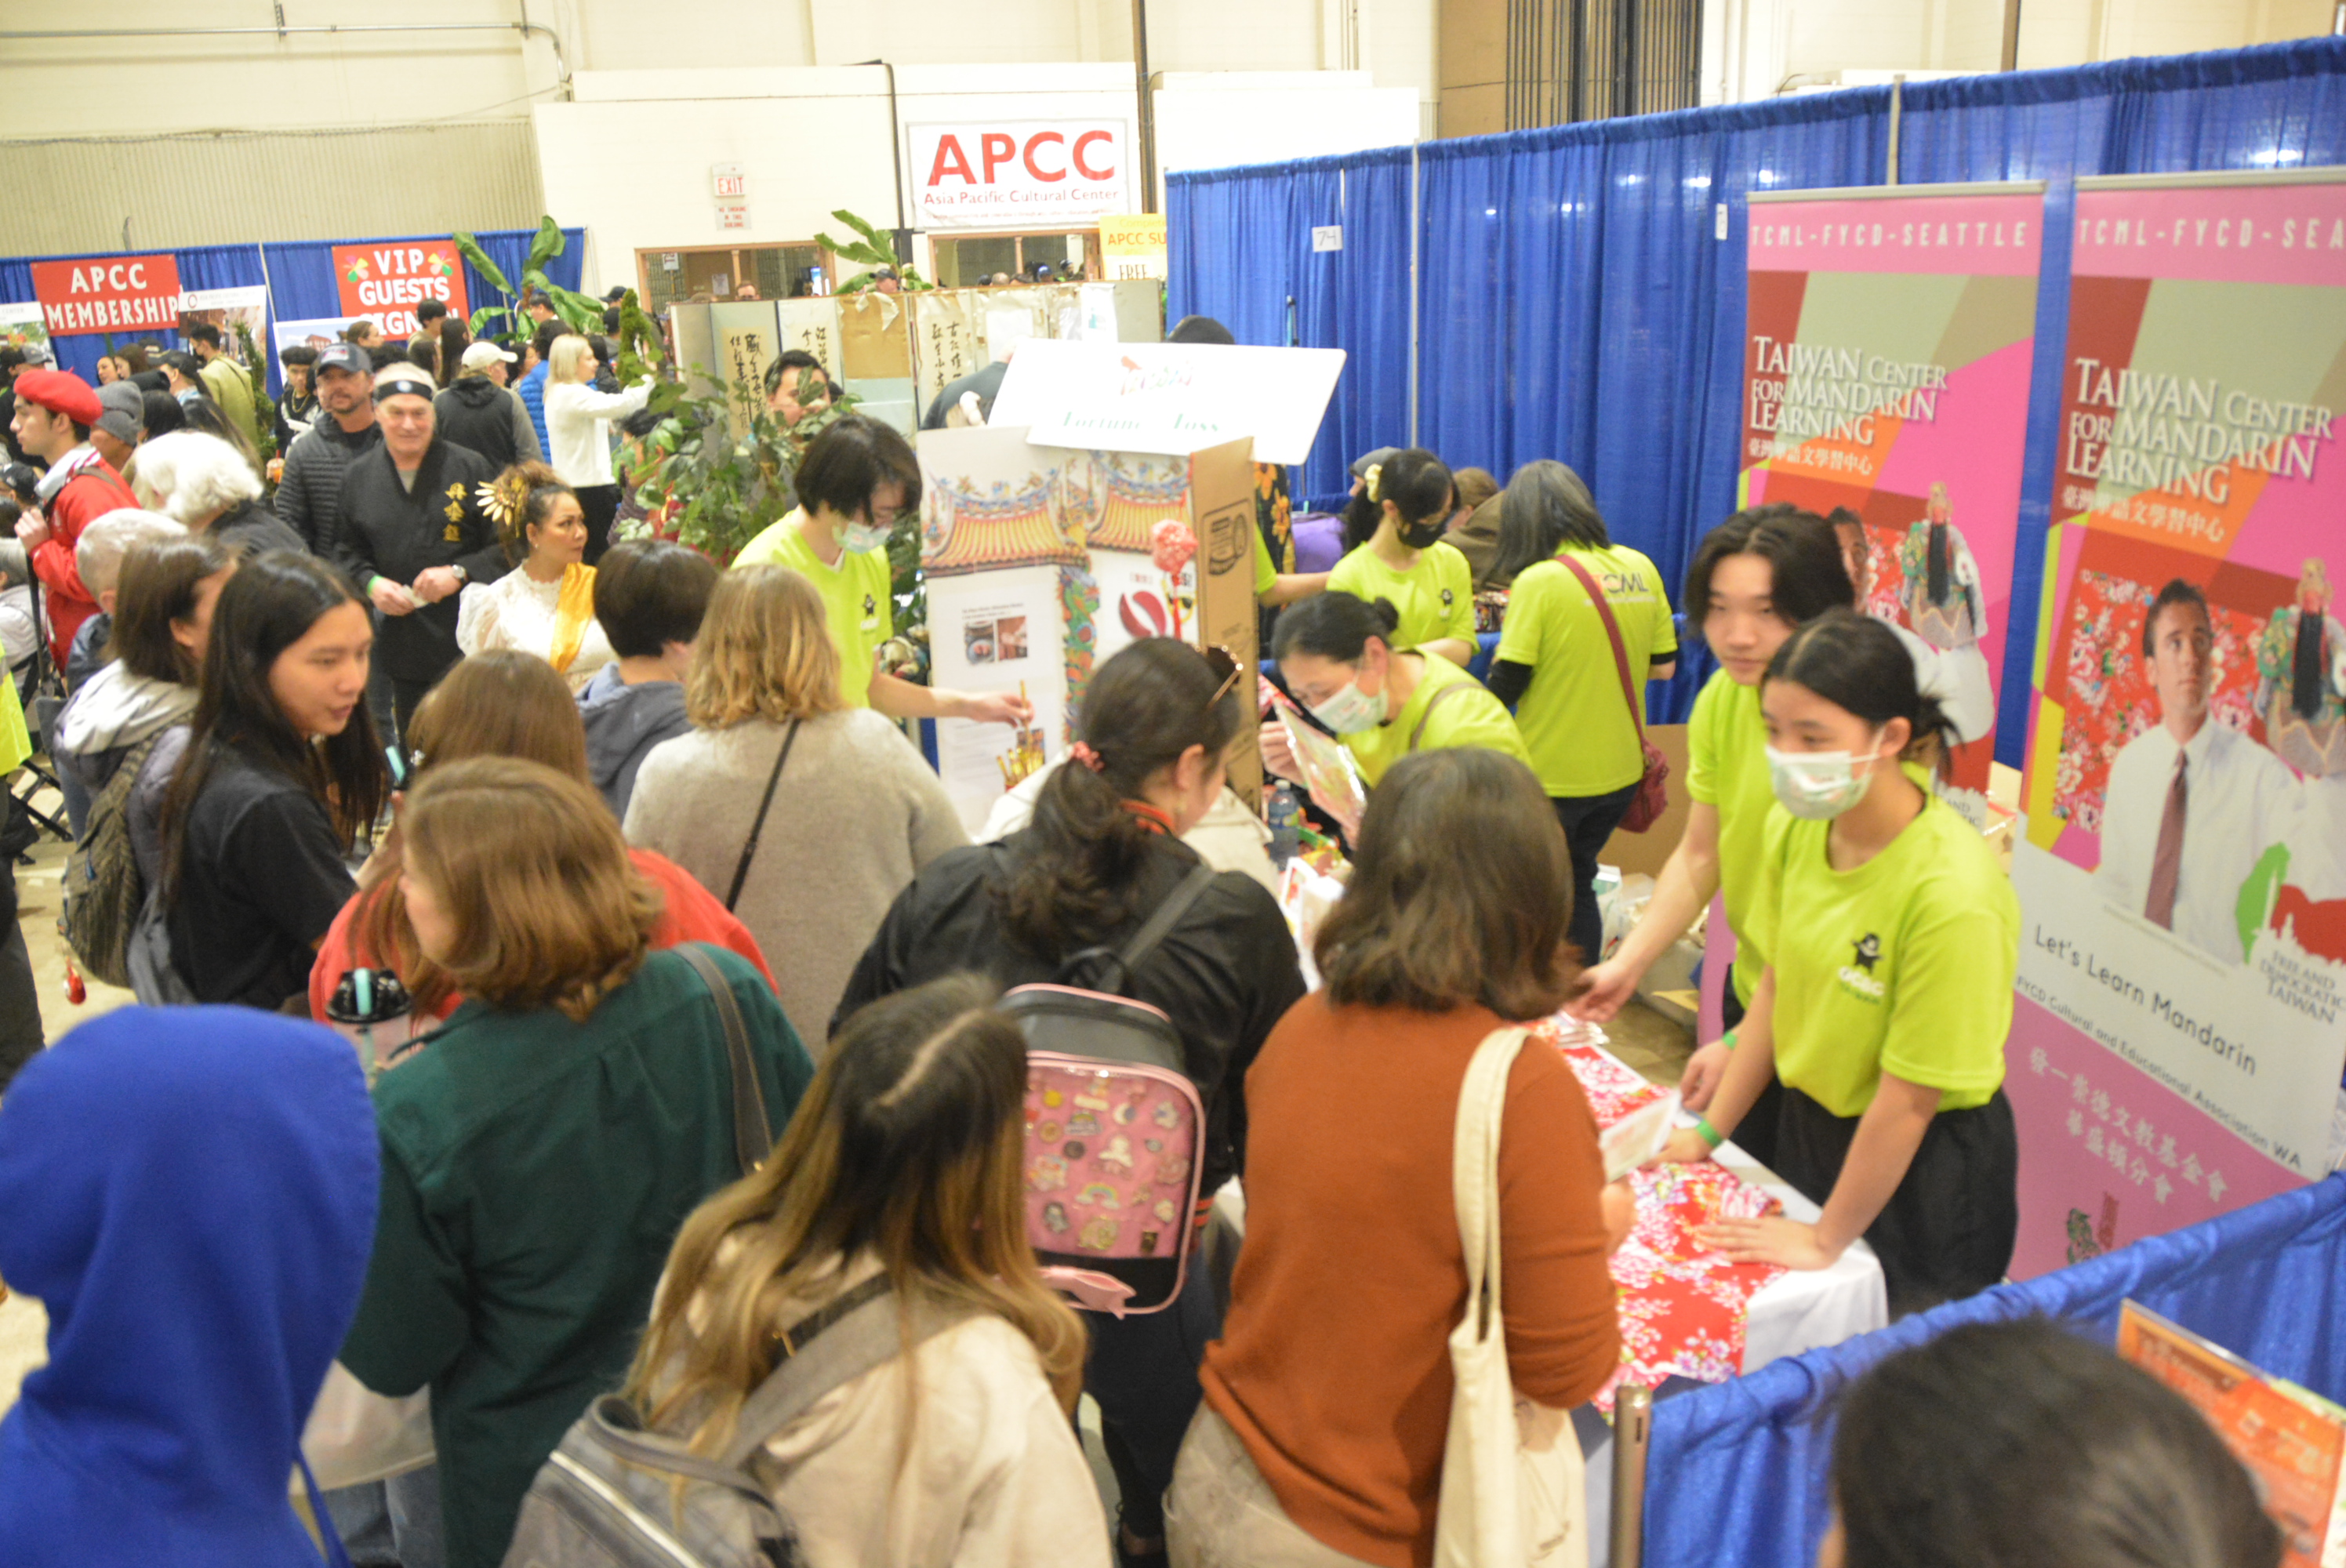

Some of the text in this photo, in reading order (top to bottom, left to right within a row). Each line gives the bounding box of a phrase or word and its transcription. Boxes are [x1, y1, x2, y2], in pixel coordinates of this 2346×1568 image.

[927, 129, 1115, 187] APCC
[717, 176, 743, 194] EXIT
[924, 188, 1119, 205] Asia Pacific Cultural Center
[373, 249, 425, 275] VIP
[1108, 232, 1145, 245] APCC
[1316, 229, 1337, 247] 74
[71, 263, 147, 294] APCC
[358, 276, 451, 306] GUESTS
[45, 296, 179, 330] MEMBERSHIP
[1753, 335, 1948, 390] TAIWAN CENTER
[1750, 396, 1875, 445] LEARNING
[1751, 372, 1937, 422] FOR MANDARIN
[2075, 357, 2333, 439] TAIWAN CENTER
[2069, 405, 2318, 480] FOR MANDARIN
[2066, 434, 2230, 505] LEARNING
[2035, 924, 2080, 967] Let's
[2087, 953, 2145, 1006] Learn
[2152, 992, 2257, 1076] Mandarin
[2267, 976, 2337, 1024] TAIWAN
[2050, 996, 2094, 1032] Cultural
[2097, 1028, 2118, 1047] and
[2120, 1040, 2192, 1095] Educational
[2195, 1090, 2269, 1149] Association
[2274, 1142, 2302, 1169] WA
